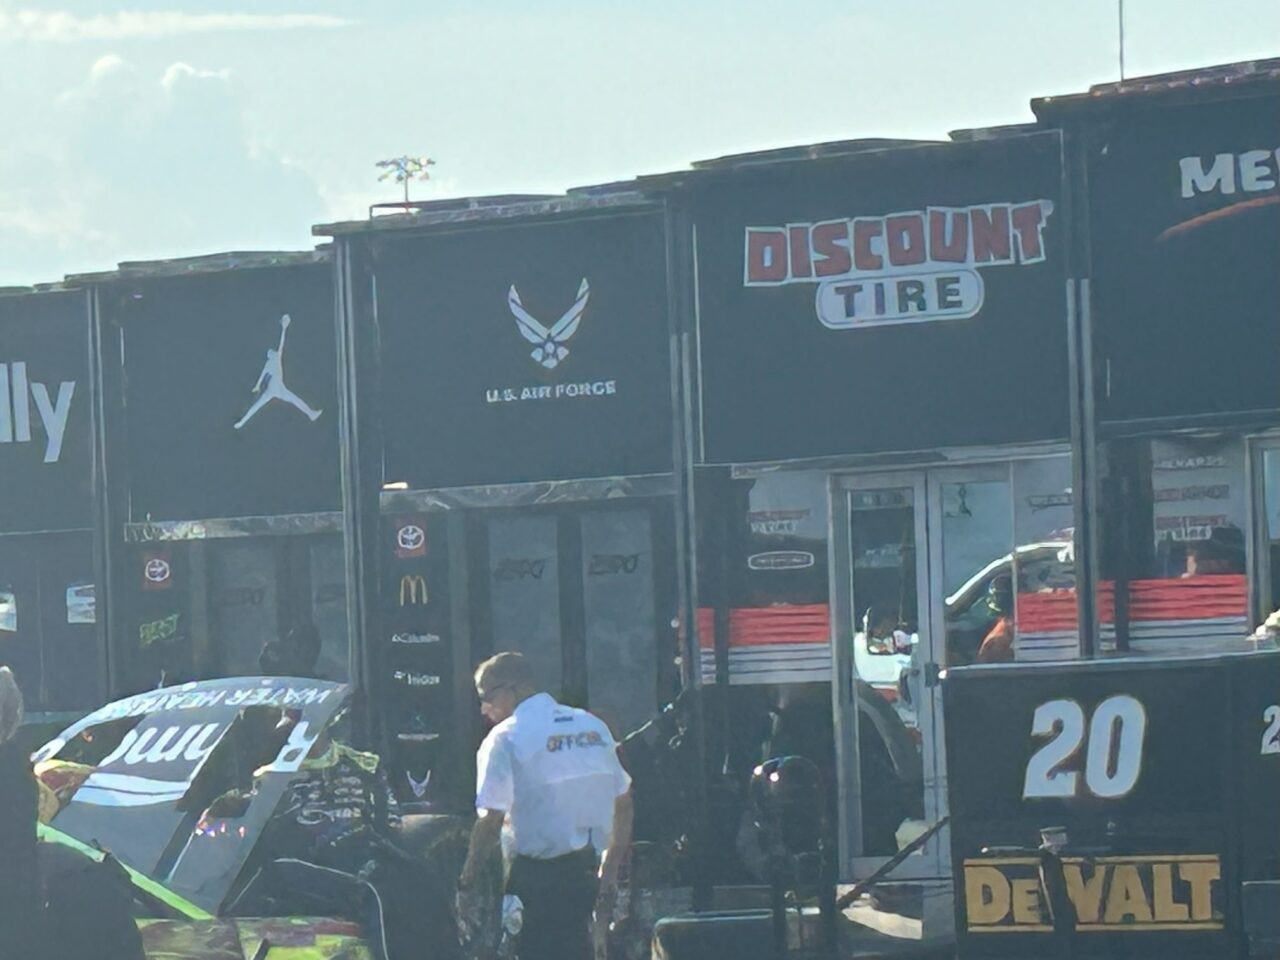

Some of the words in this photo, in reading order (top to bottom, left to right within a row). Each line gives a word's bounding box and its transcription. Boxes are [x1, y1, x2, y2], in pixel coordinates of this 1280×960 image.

[1179, 147, 1280, 198] ME
[744, 201, 1054, 286] DISCOUNT
[834, 276, 964, 318] TIRE
[520, 386, 552, 400] AIR
[555, 380, 616, 398] FORCE
[1023, 695, 1147, 800] 20
